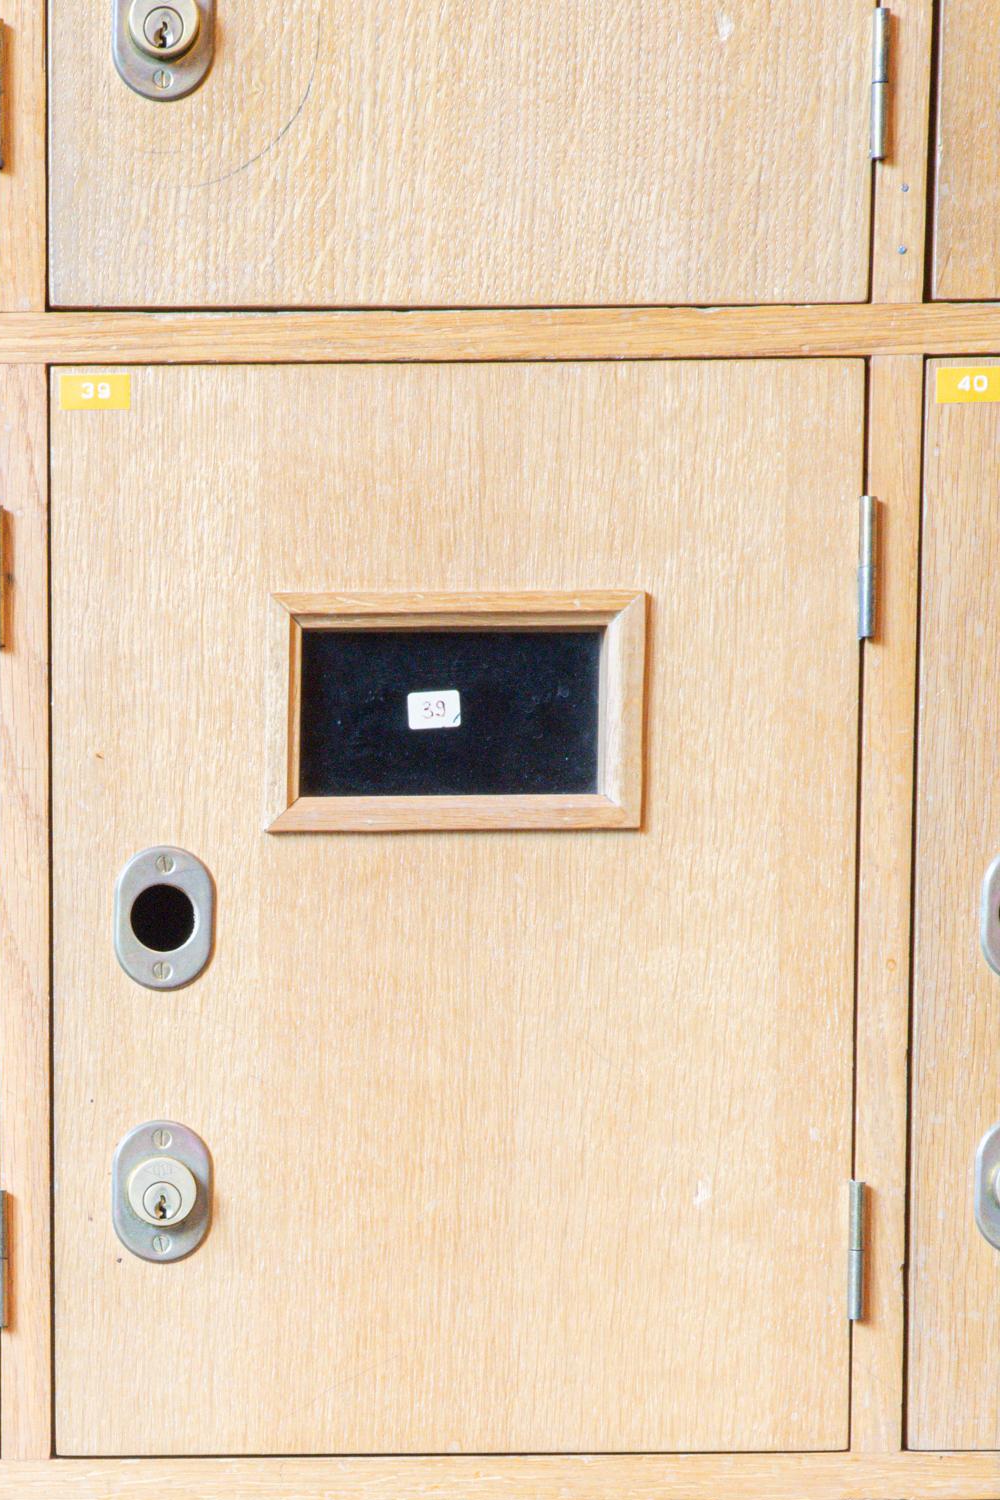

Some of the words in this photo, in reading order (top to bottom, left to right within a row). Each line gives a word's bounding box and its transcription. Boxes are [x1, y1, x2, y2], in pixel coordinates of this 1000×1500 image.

[80, 381, 111, 400] 39
[957, 374, 989, 393] 40
[423, 700, 446, 719] 39
